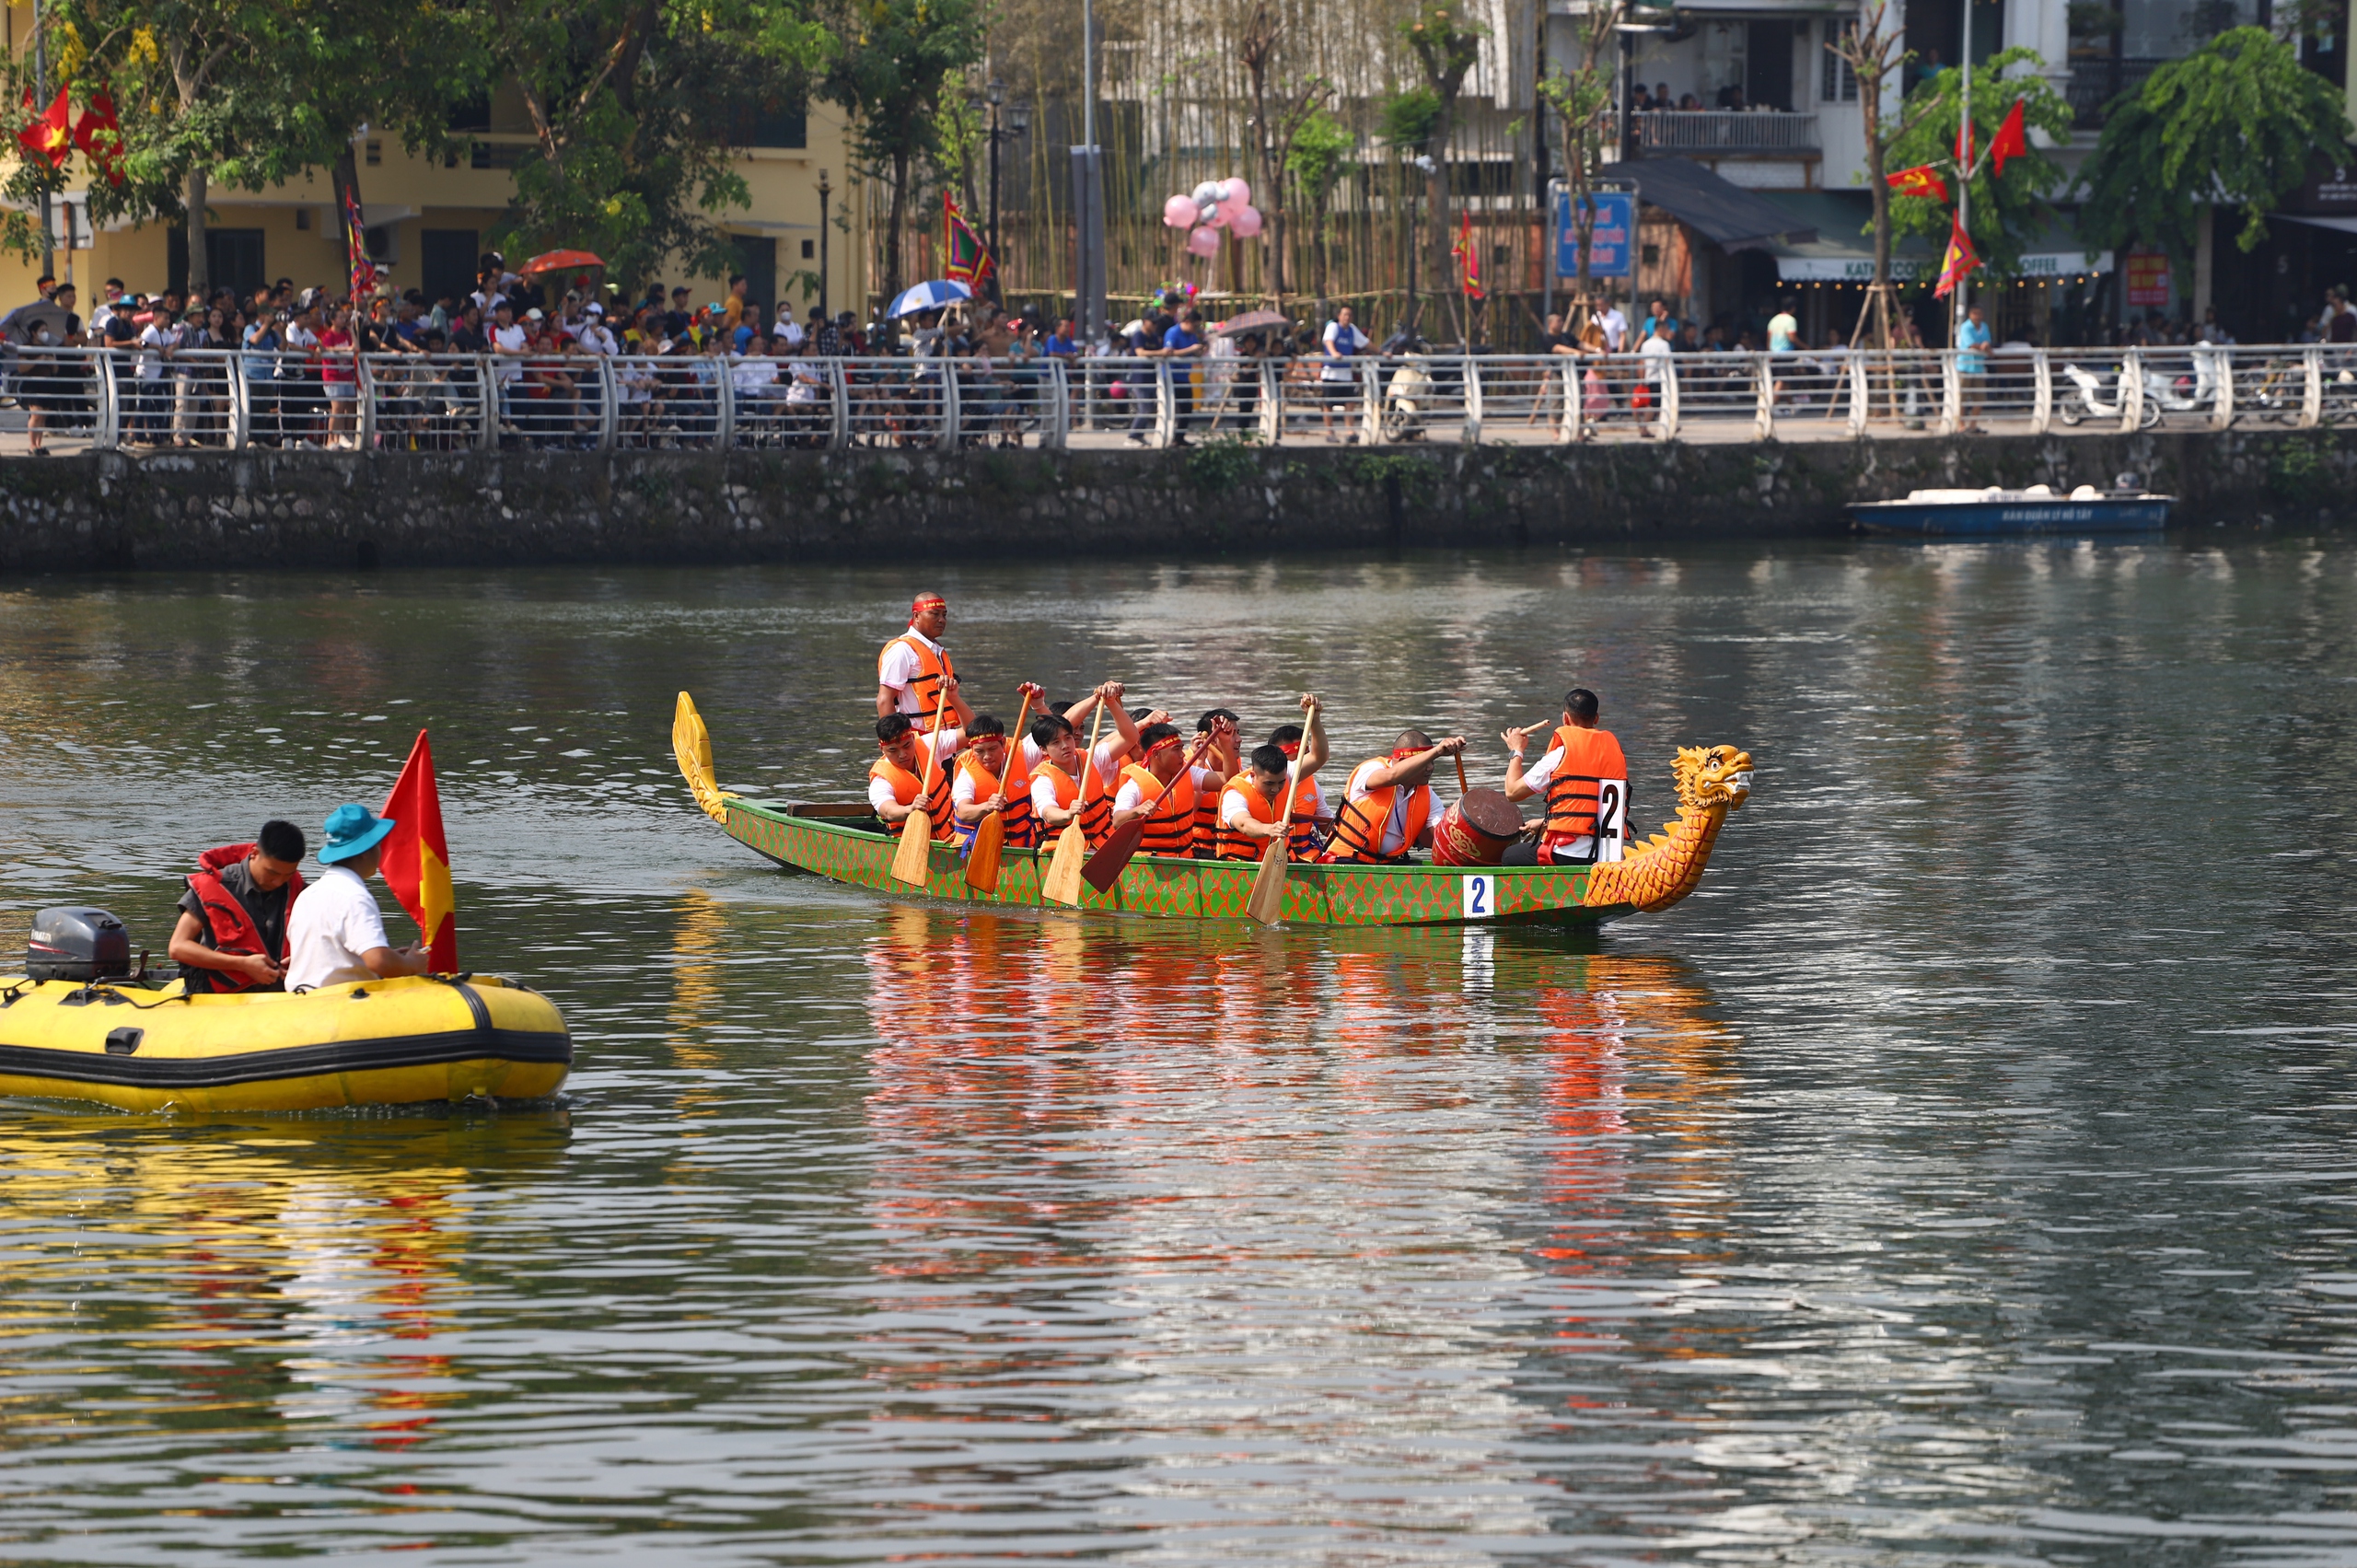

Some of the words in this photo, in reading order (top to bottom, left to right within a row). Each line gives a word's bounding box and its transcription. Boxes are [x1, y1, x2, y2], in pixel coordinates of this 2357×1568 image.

[2020, 257, 2057, 273] OFFEE
[1601, 784, 1619, 838] 2
[1472, 877, 1485, 912] 2
